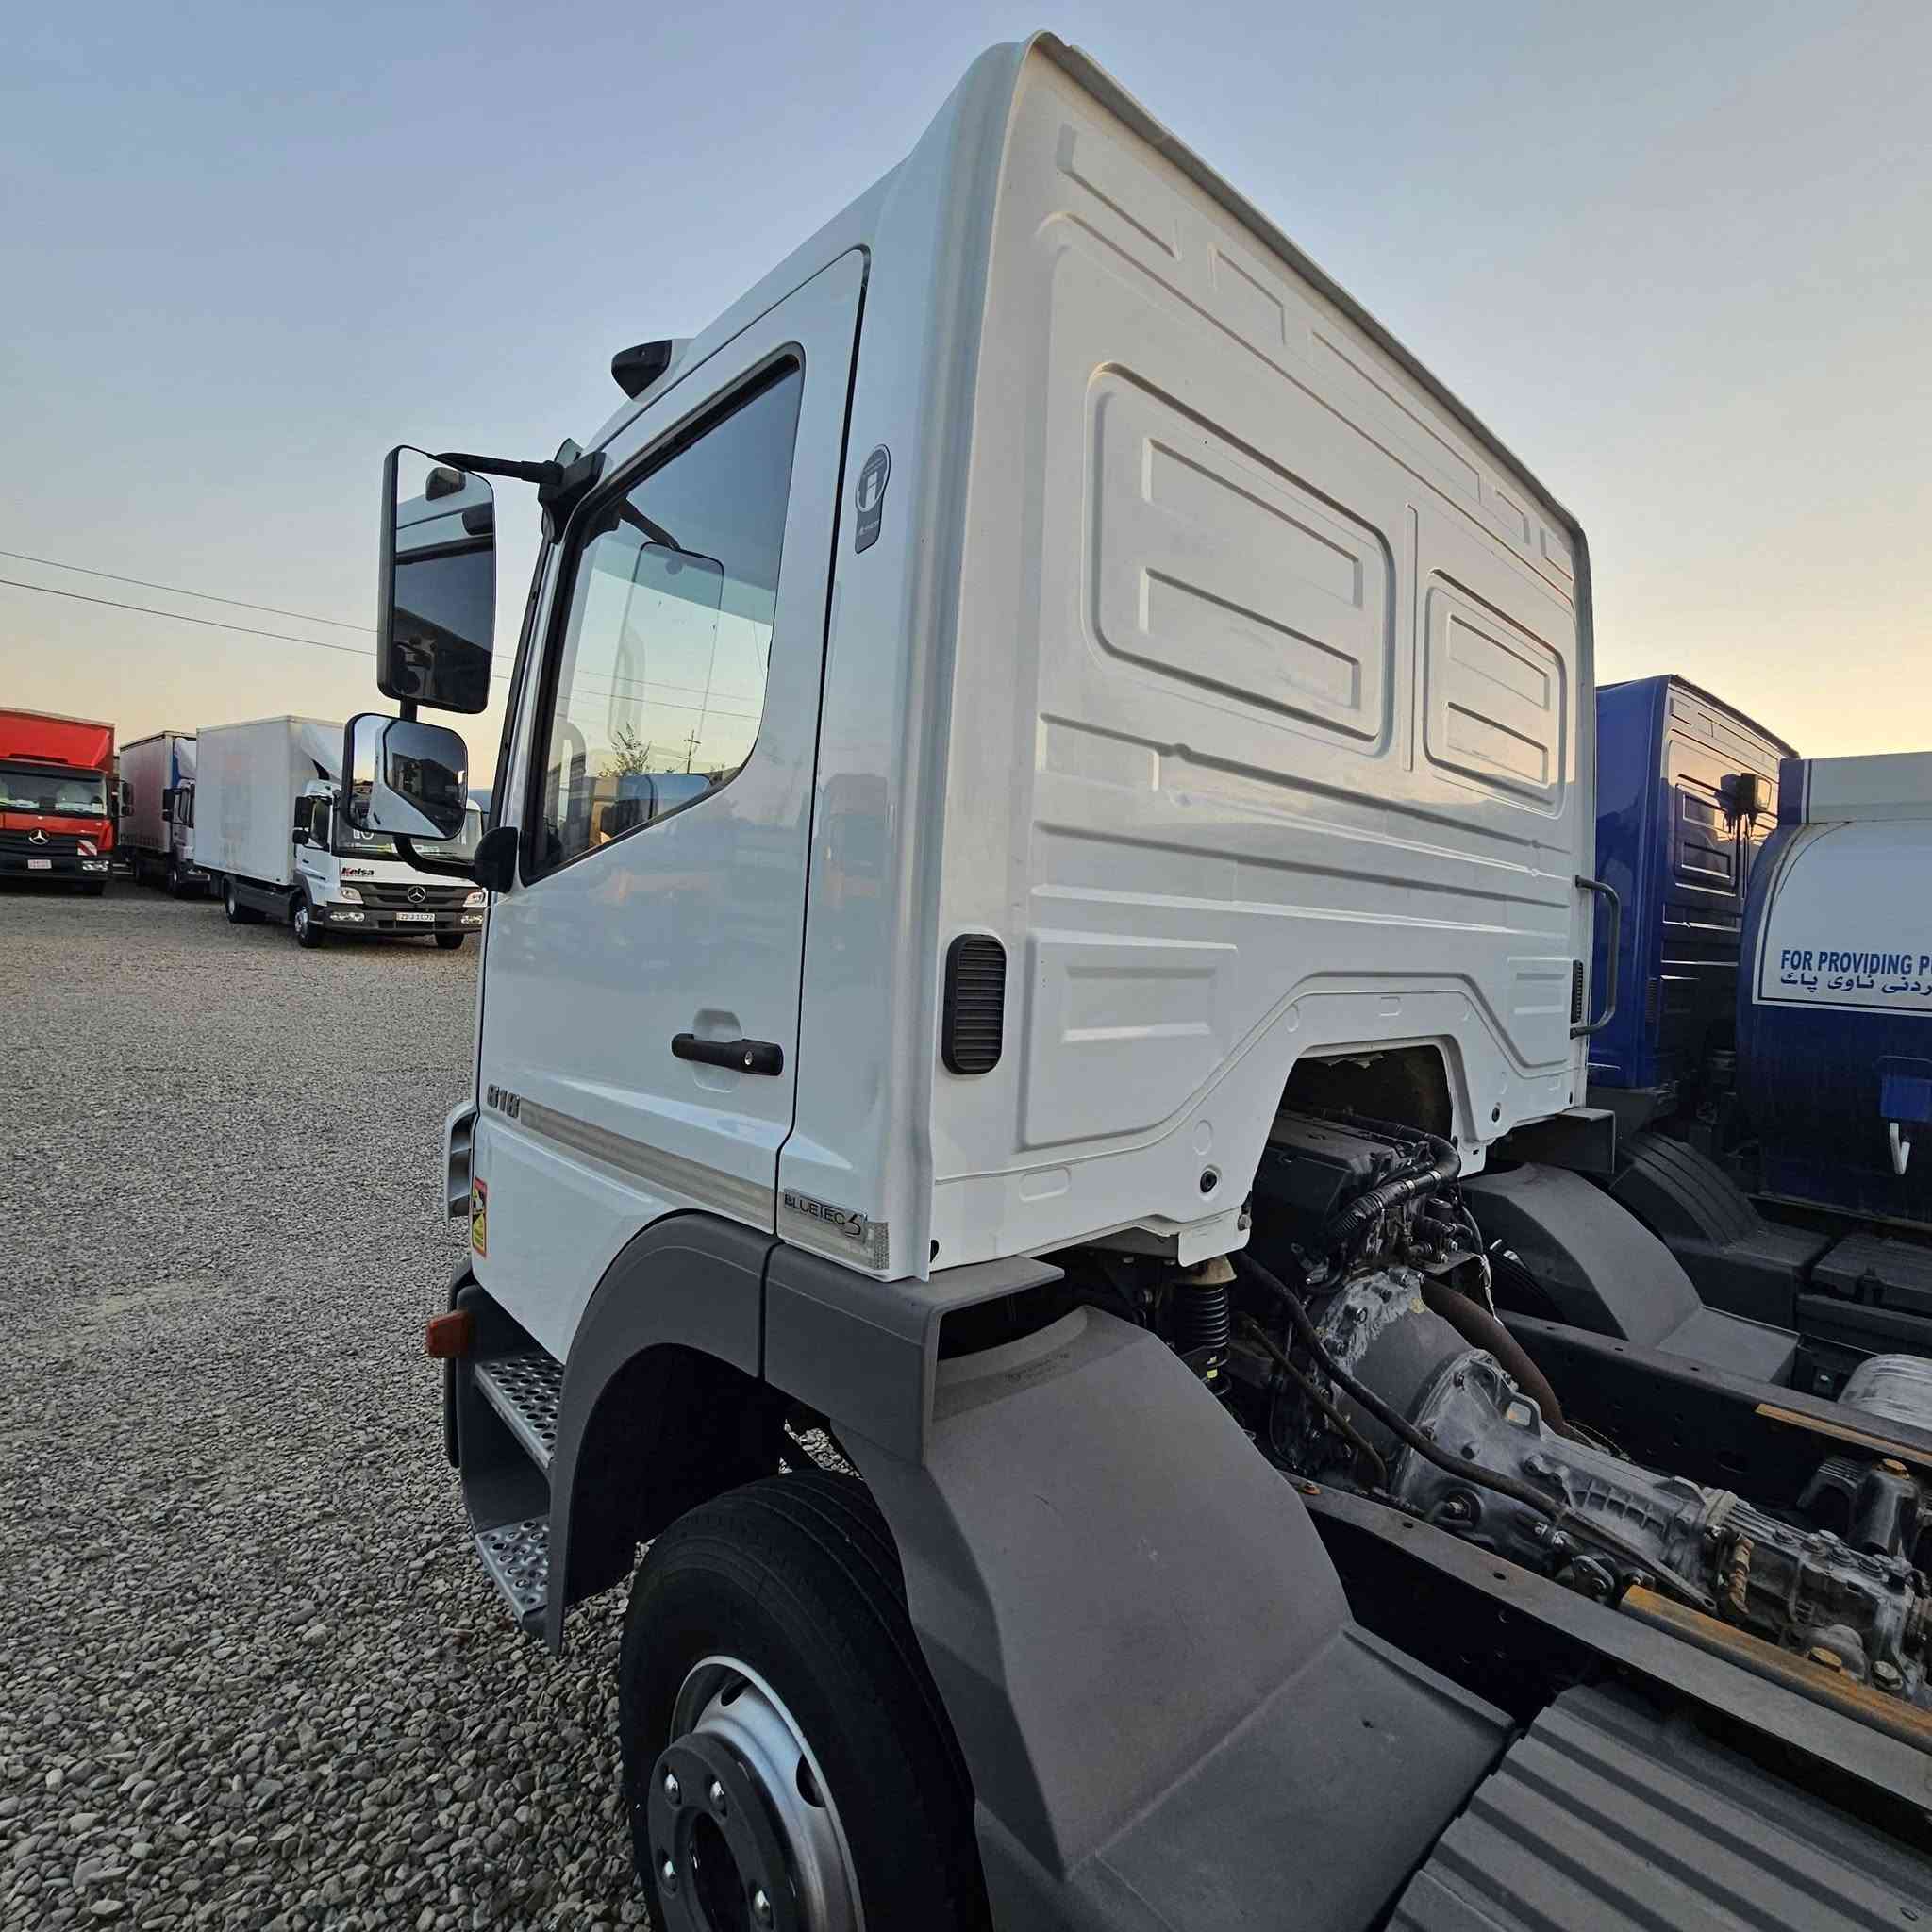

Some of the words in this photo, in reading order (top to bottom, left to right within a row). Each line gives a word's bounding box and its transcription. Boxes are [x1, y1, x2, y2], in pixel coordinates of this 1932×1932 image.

[1781, 950, 1812, 970] FOR
[1818, 951, 1912, 975] PROVIDING
[1918, 955, 1932, 976] P
